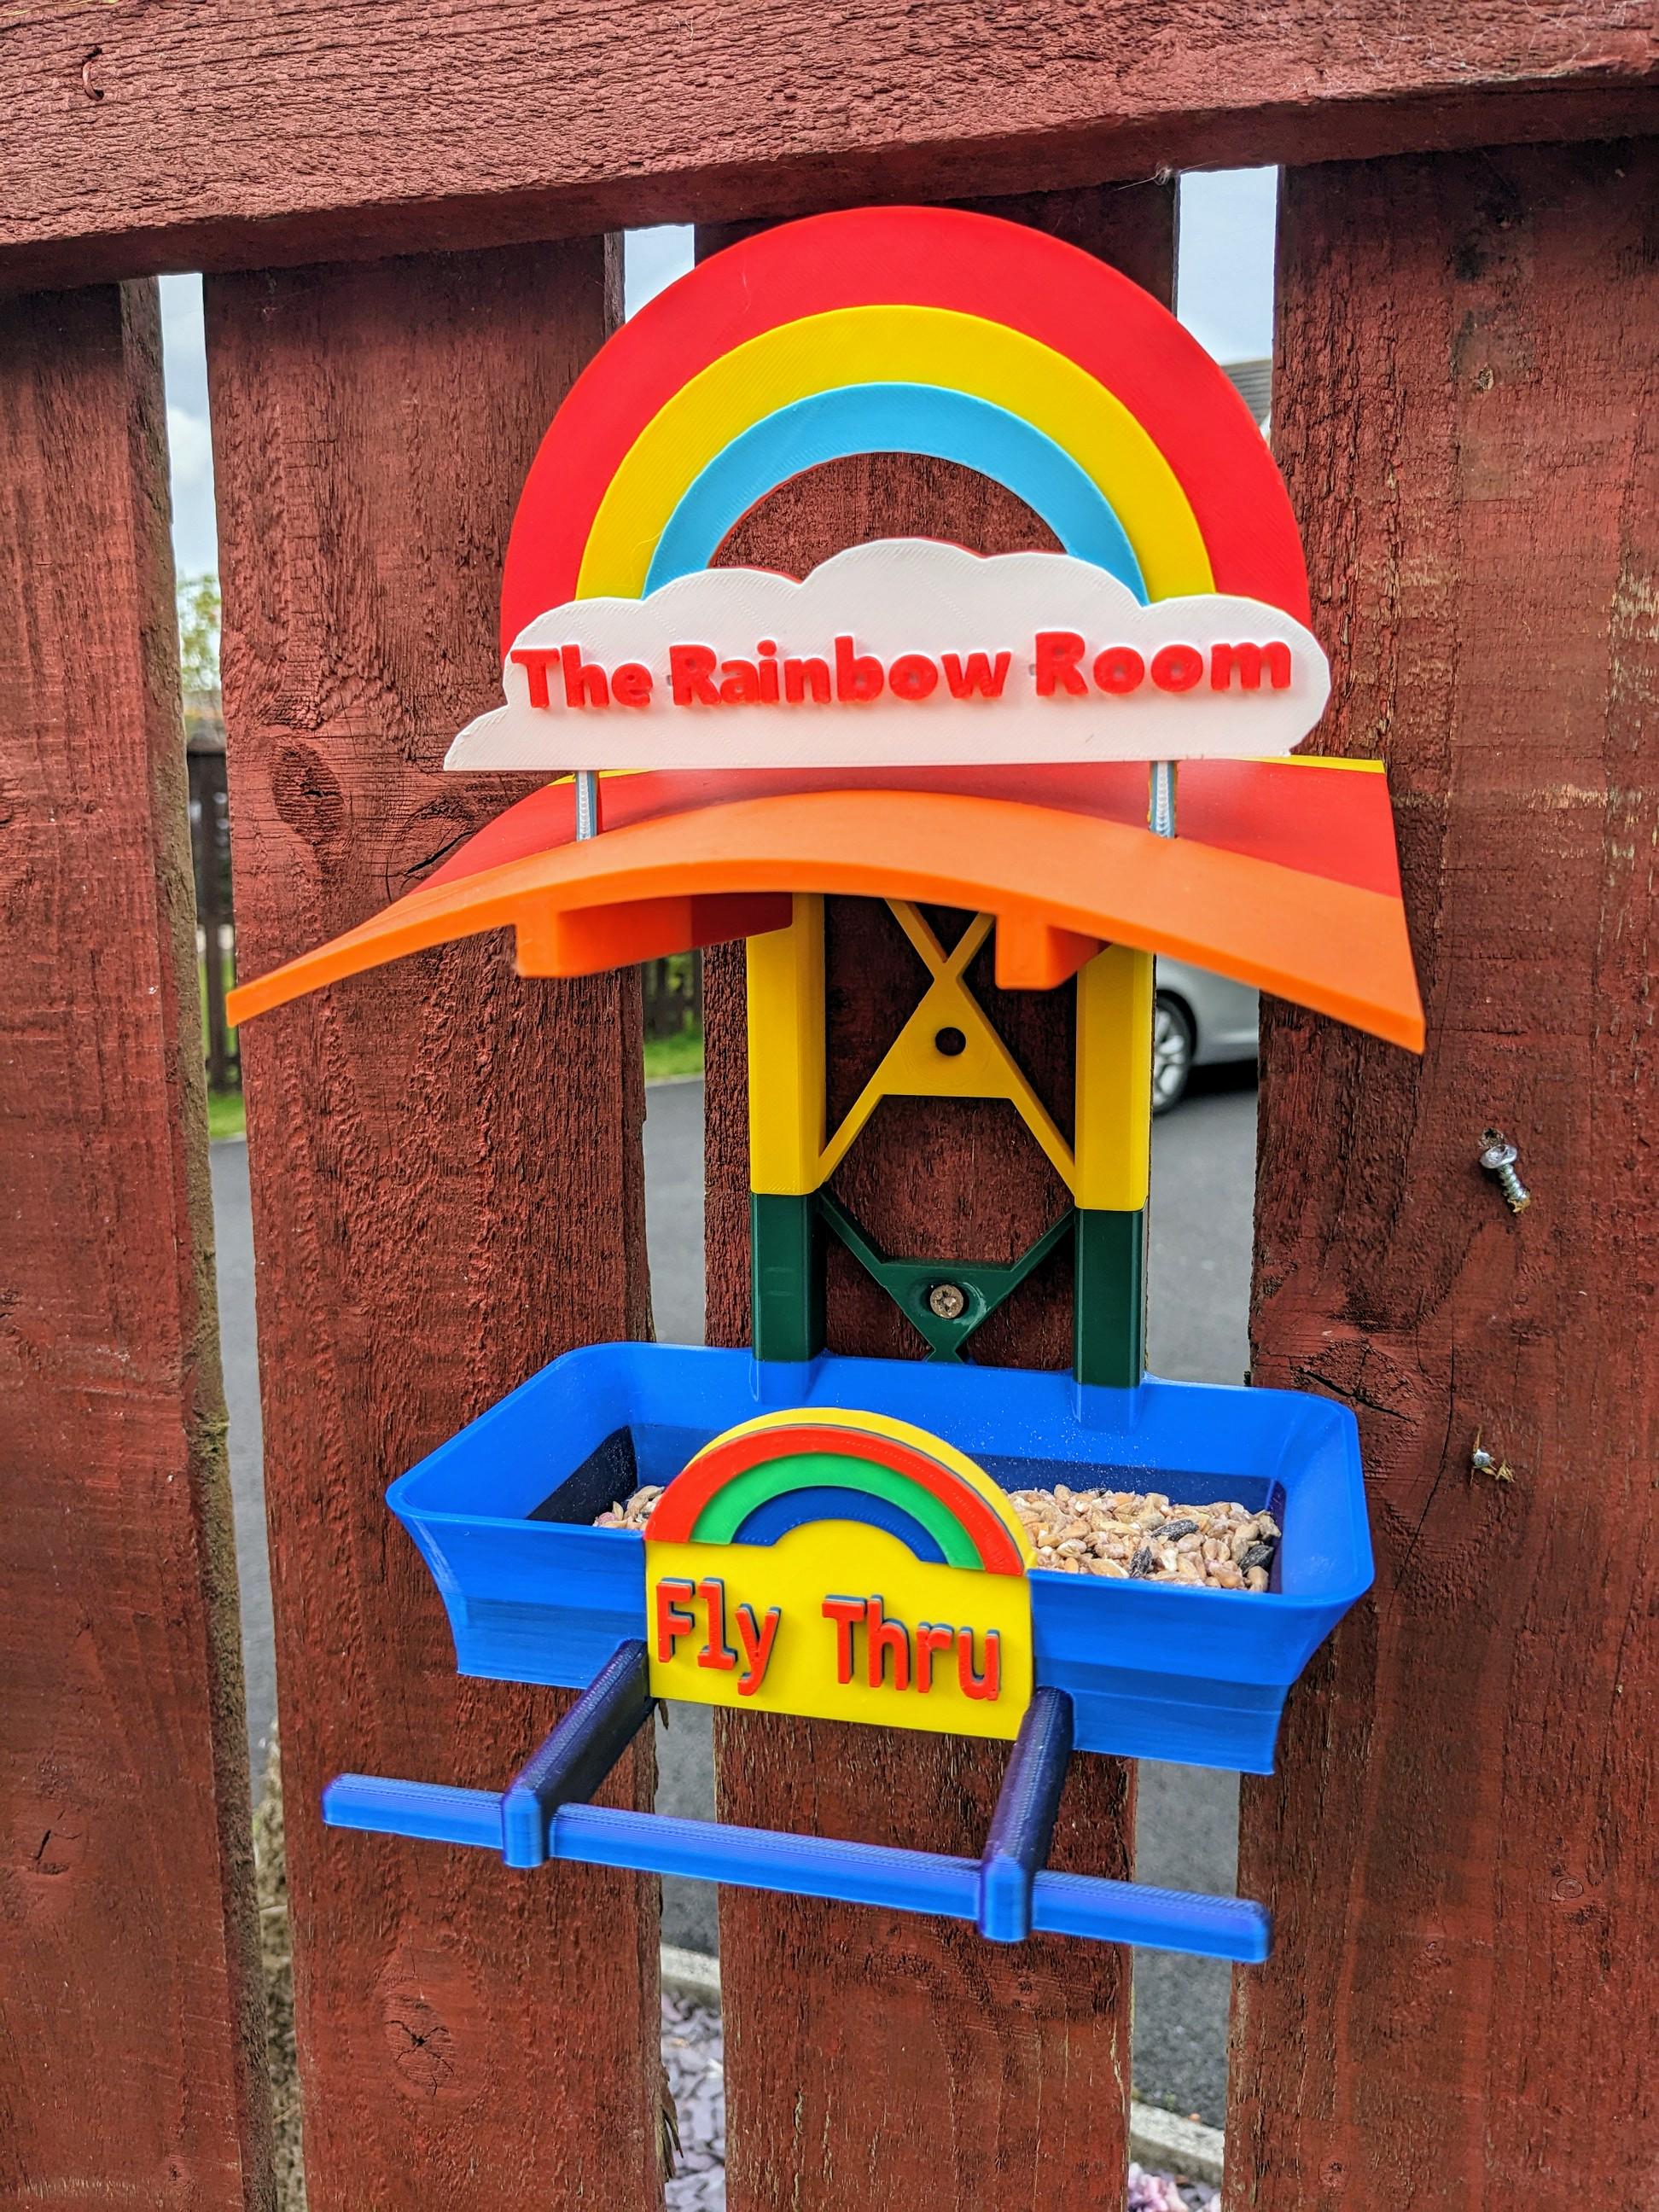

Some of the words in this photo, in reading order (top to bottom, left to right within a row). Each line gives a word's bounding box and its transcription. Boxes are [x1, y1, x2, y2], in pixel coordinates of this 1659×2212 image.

[511, 644, 652, 709] The
[669, 635, 1013, 707] Rainbow
[1033, 631, 1292, 697] Room
[656, 1577, 782, 1697] Fly
[822, 1594, 1001, 1702] Thru
